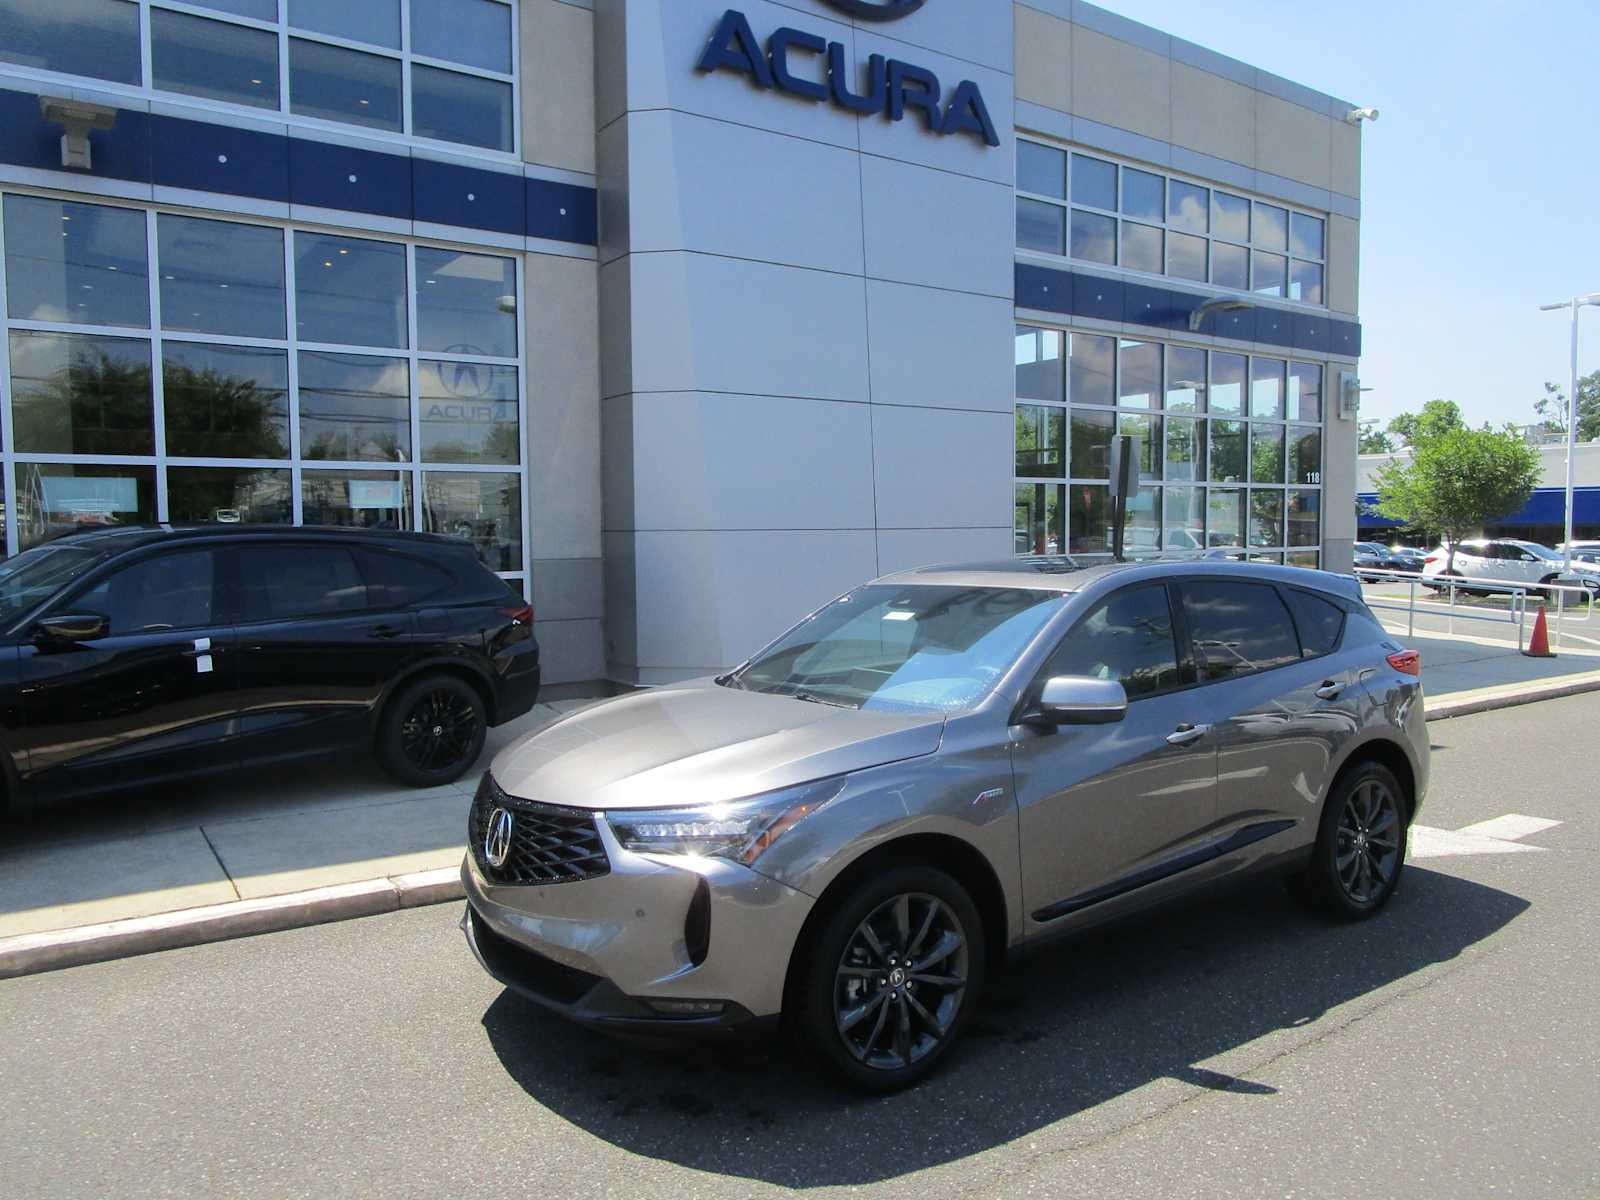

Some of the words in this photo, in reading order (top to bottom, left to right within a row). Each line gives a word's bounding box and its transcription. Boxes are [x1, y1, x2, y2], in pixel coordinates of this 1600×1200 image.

[695, 9, 1000, 147] ACURA
[426, 405, 507, 424] ACURA
[1306, 472, 1320, 483] 118
